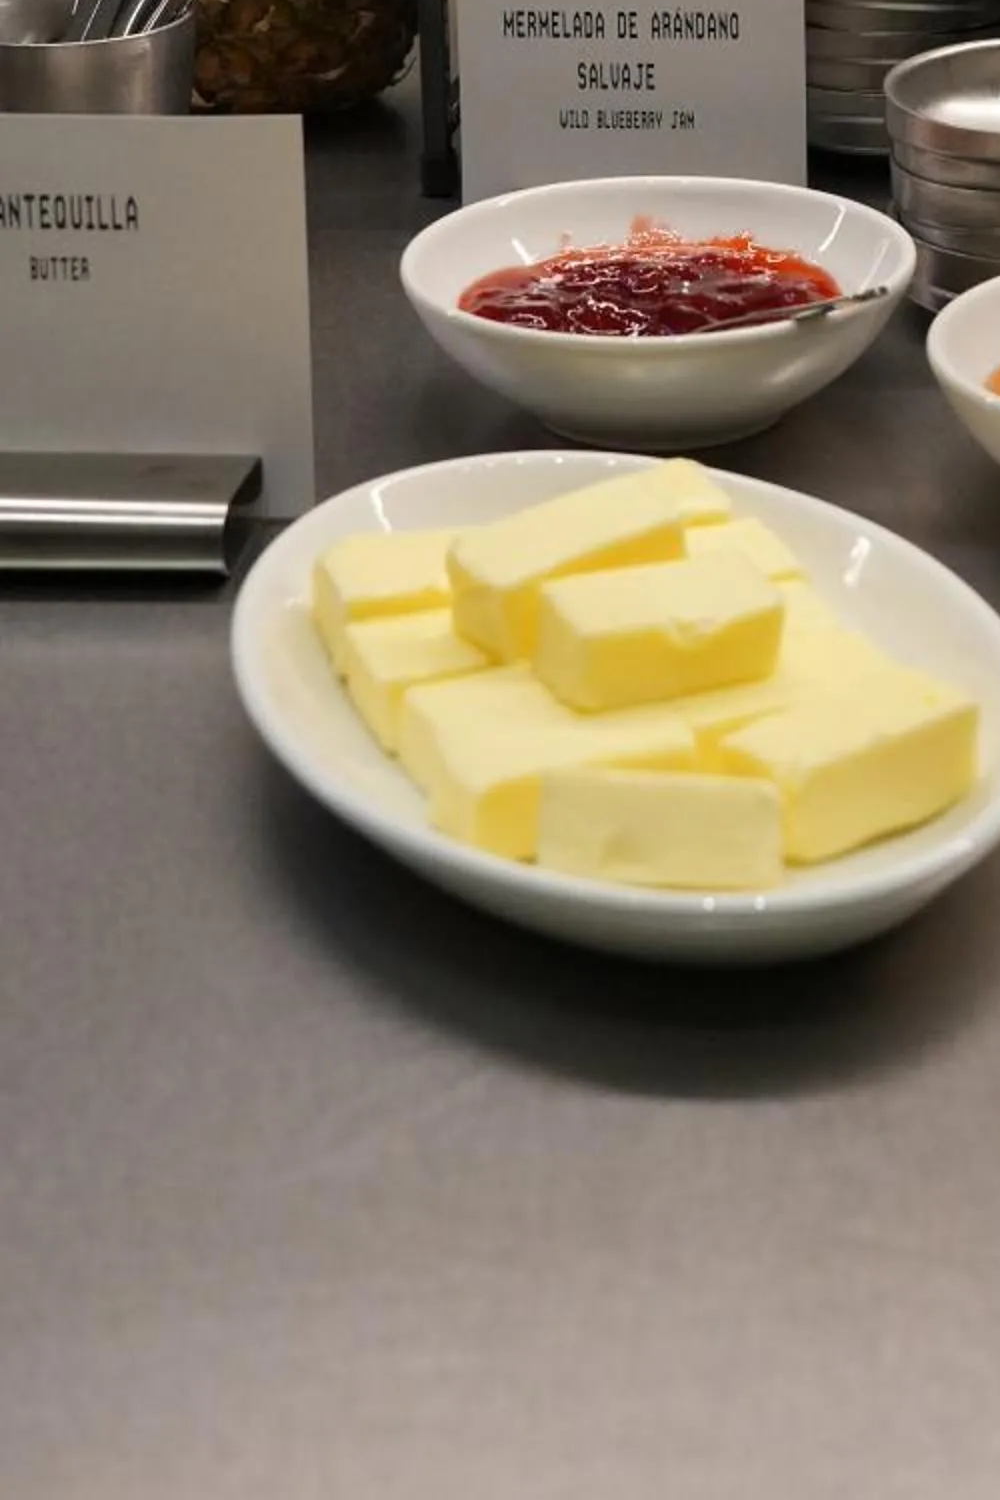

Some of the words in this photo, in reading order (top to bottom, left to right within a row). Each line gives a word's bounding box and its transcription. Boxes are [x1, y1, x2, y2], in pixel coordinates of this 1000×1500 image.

[503, 10, 605, 40] MERMELADA
[617, 11, 639, 40] DE
[651, 7, 740, 41] ARÁNDANO
[577, 61, 656, 91] SALVAJE
[559, 109, 589, 130] WILD
[597, 109, 663, 130] BLUEBERRY
[671, 110, 695, 130] JAM
[29, 256, 90, 281] BUTTER
